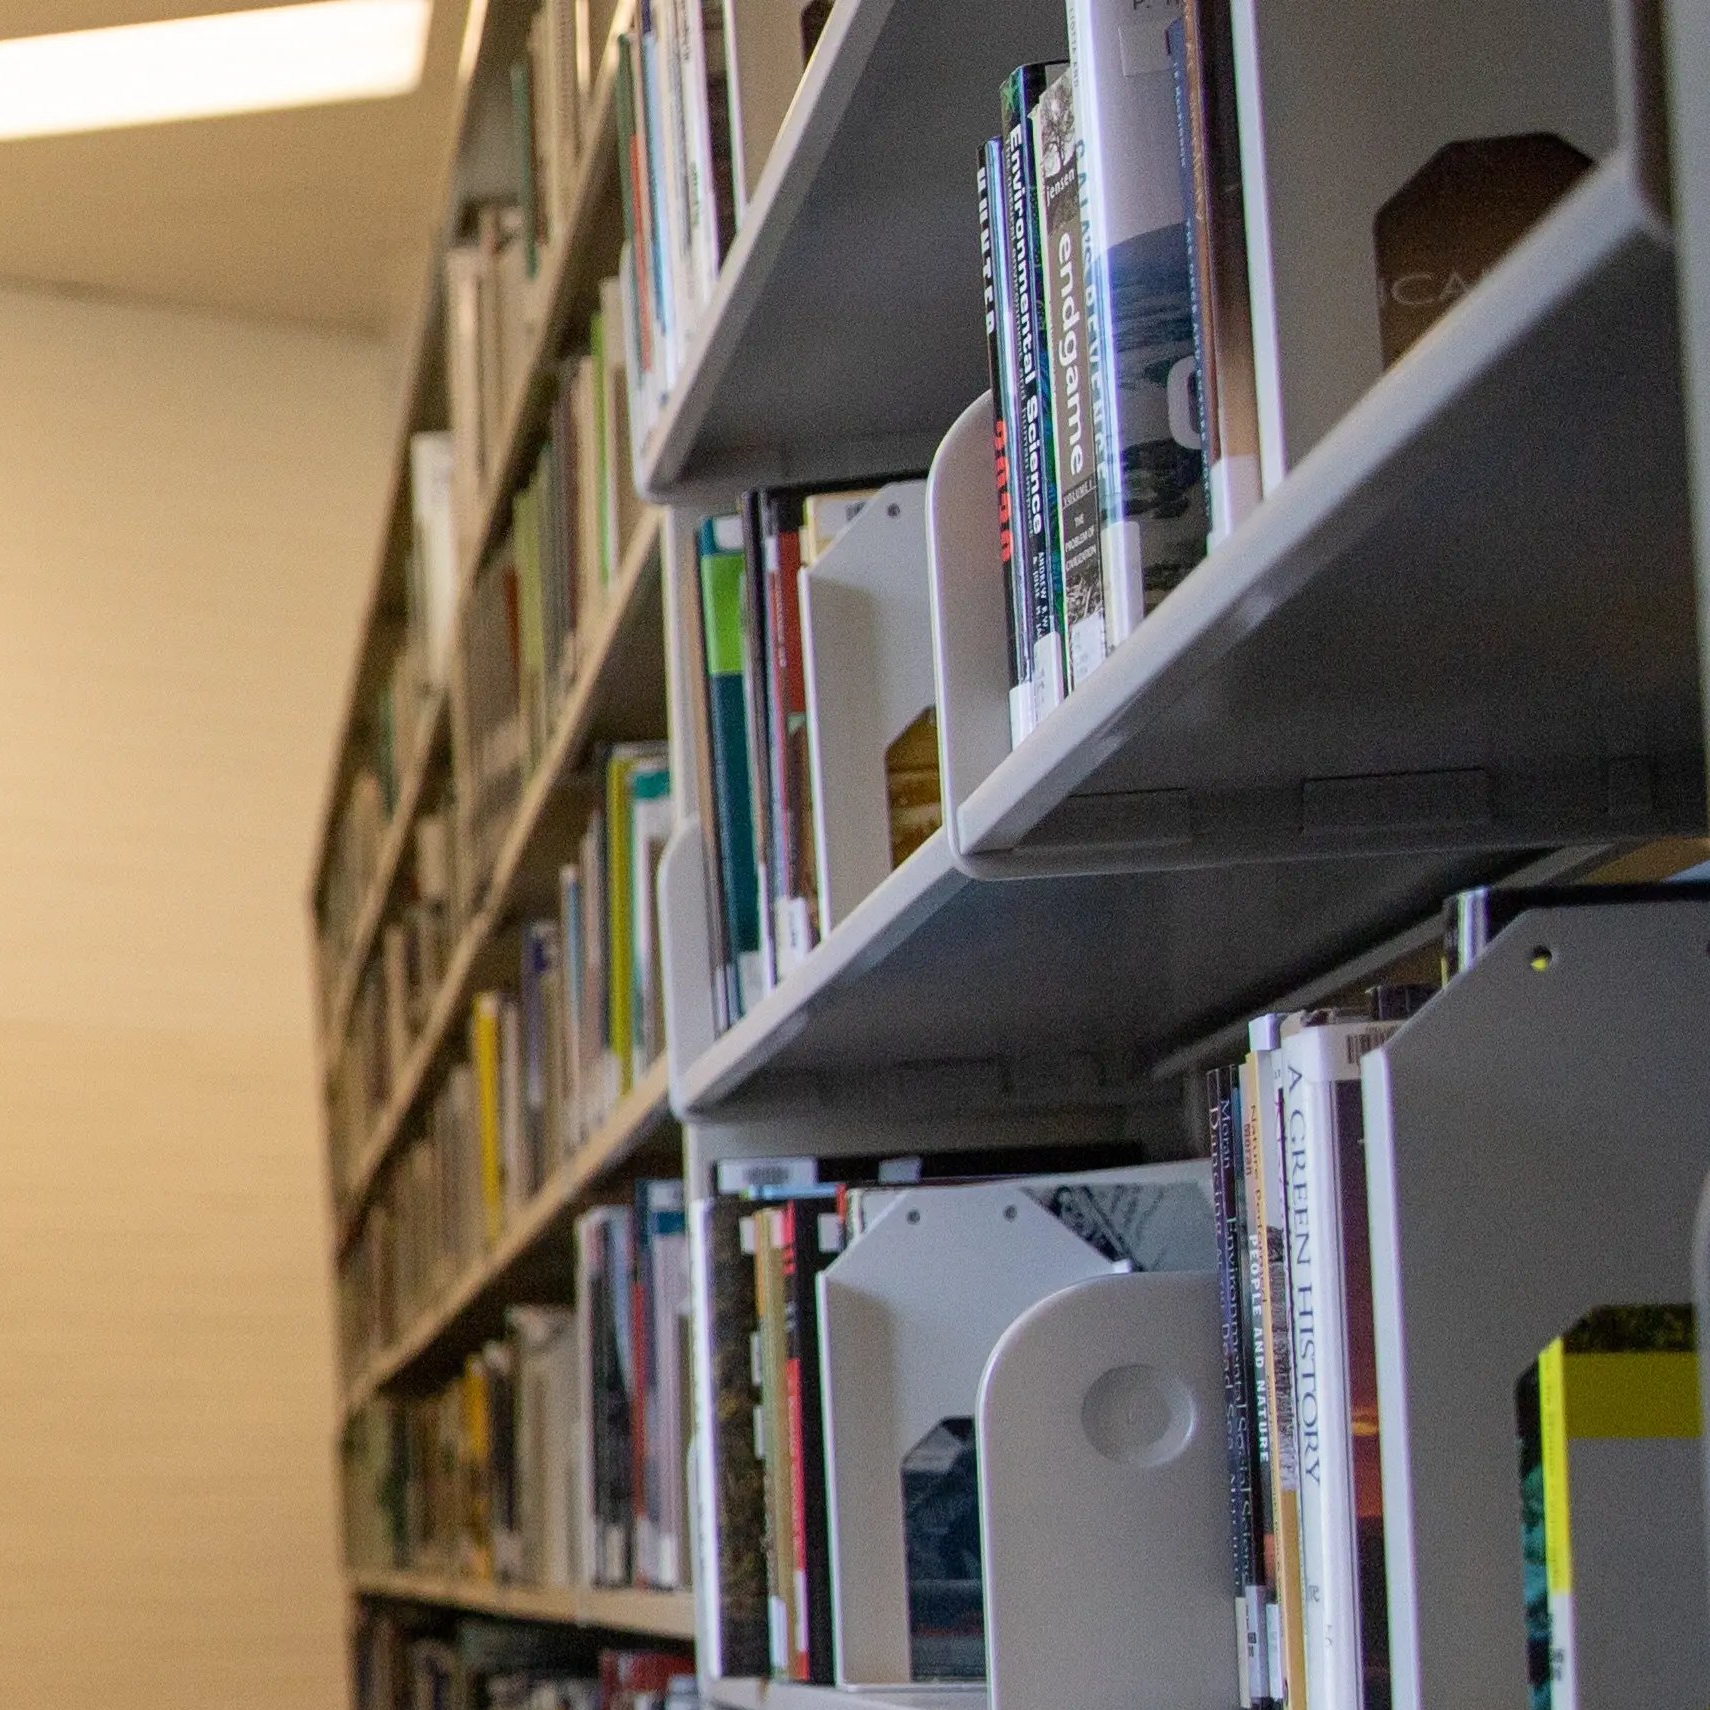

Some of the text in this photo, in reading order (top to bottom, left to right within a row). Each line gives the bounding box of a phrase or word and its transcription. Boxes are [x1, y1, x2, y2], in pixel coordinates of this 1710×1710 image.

[1046, 167, 1075, 206] jensen
[1382, 272, 1467, 305] CA
[1009, 123, 1043, 536] Environmental Science
[1058, 232, 1083, 475] endgame
[1038, 552, 1047, 599] ANDREW
[1210, 1106, 1224, 1236] Dancing
[1221, 1323, 1233, 1389] Dead
[1219, 1100, 1253, 1586] Moran Environmental Social Scienc
[1248, 1235, 1269, 1463] PEOPLE AND NATURE
[1287, 1066, 1321, 1486] A GREEN HISTORY
